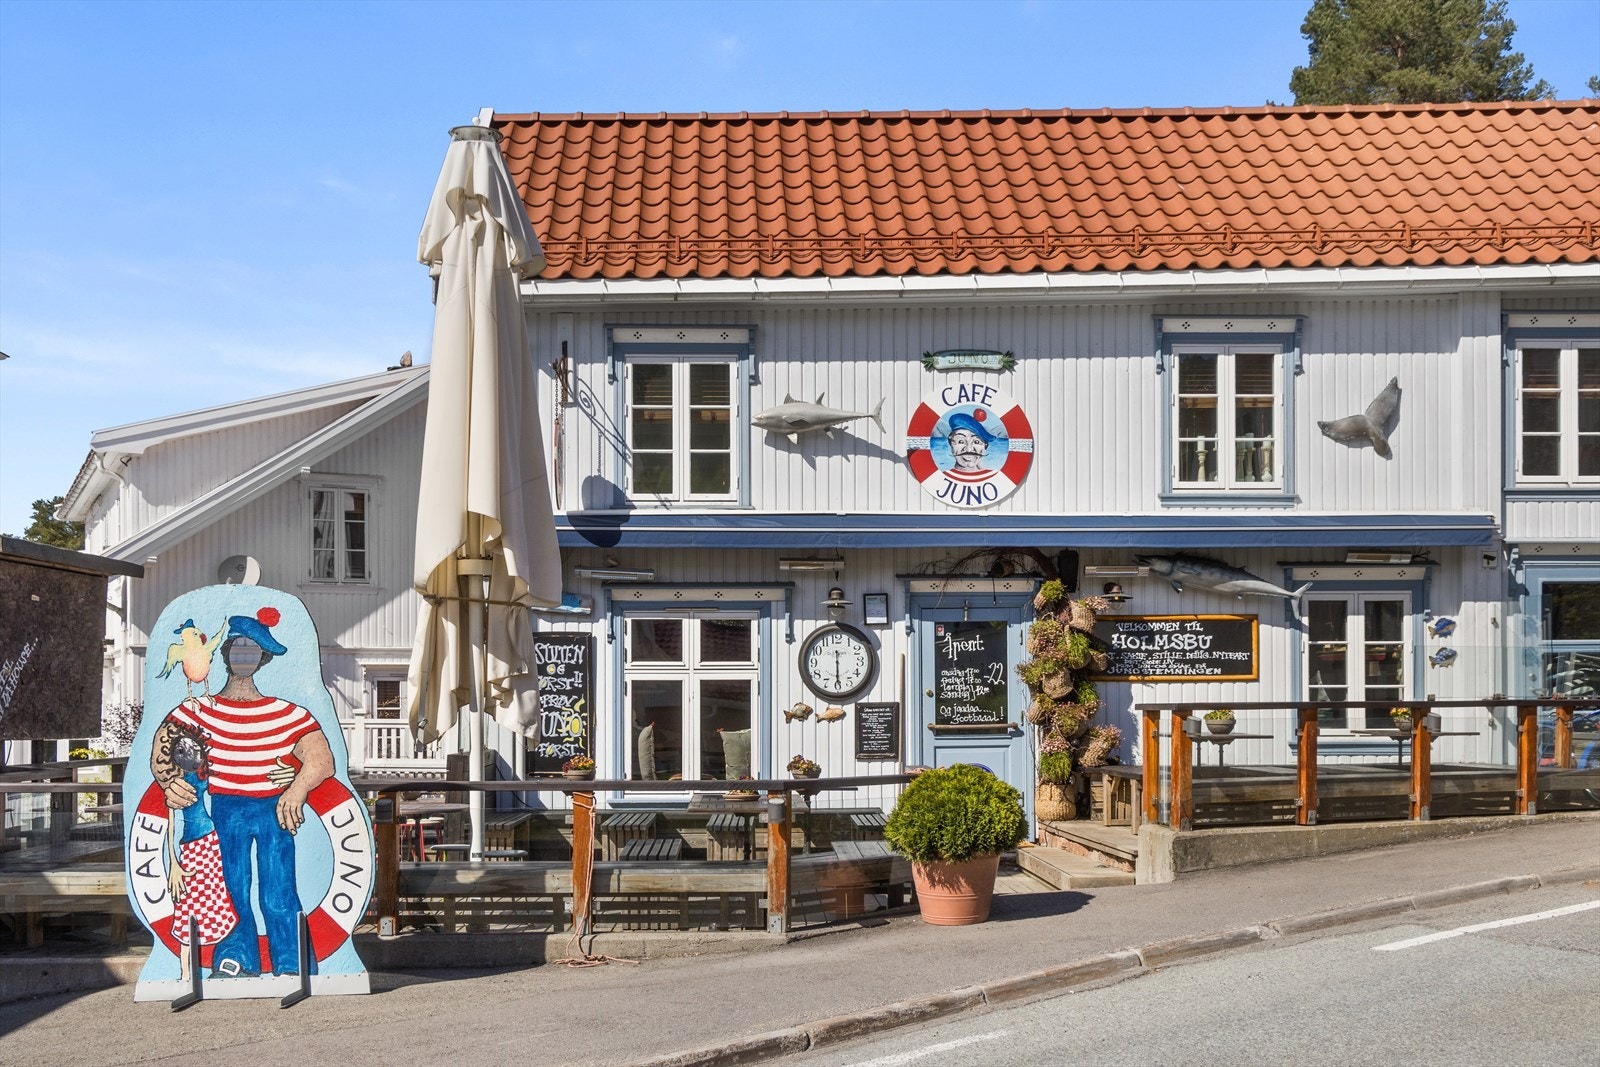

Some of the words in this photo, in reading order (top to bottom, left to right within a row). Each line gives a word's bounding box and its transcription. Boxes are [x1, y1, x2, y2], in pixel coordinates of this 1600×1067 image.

[948, 353, 989, 364] JUNO
[941, 383, 998, 408] CAFE
[936, 477, 998, 506] JUNO
[1116, 621, 1180, 631] VELKOMMEN
[1184, 621, 1203, 631] TIL
[1111, 633, 1213, 650] HOLMSBU
[534, 643, 586, 664] SULTEN
[853, 645, 861, 656] 2
[810, 658, 818, 668] 9
[856, 656, 864, 667] 3
[546, 664, 566, 675] OG
[813, 669, 821, 680] 8
[852, 668, 861, 677] 4
[823, 678, 830, 688] 7
[135, 816, 165, 905] CAFÉ
[330, 808, 364, 915] JUNO
